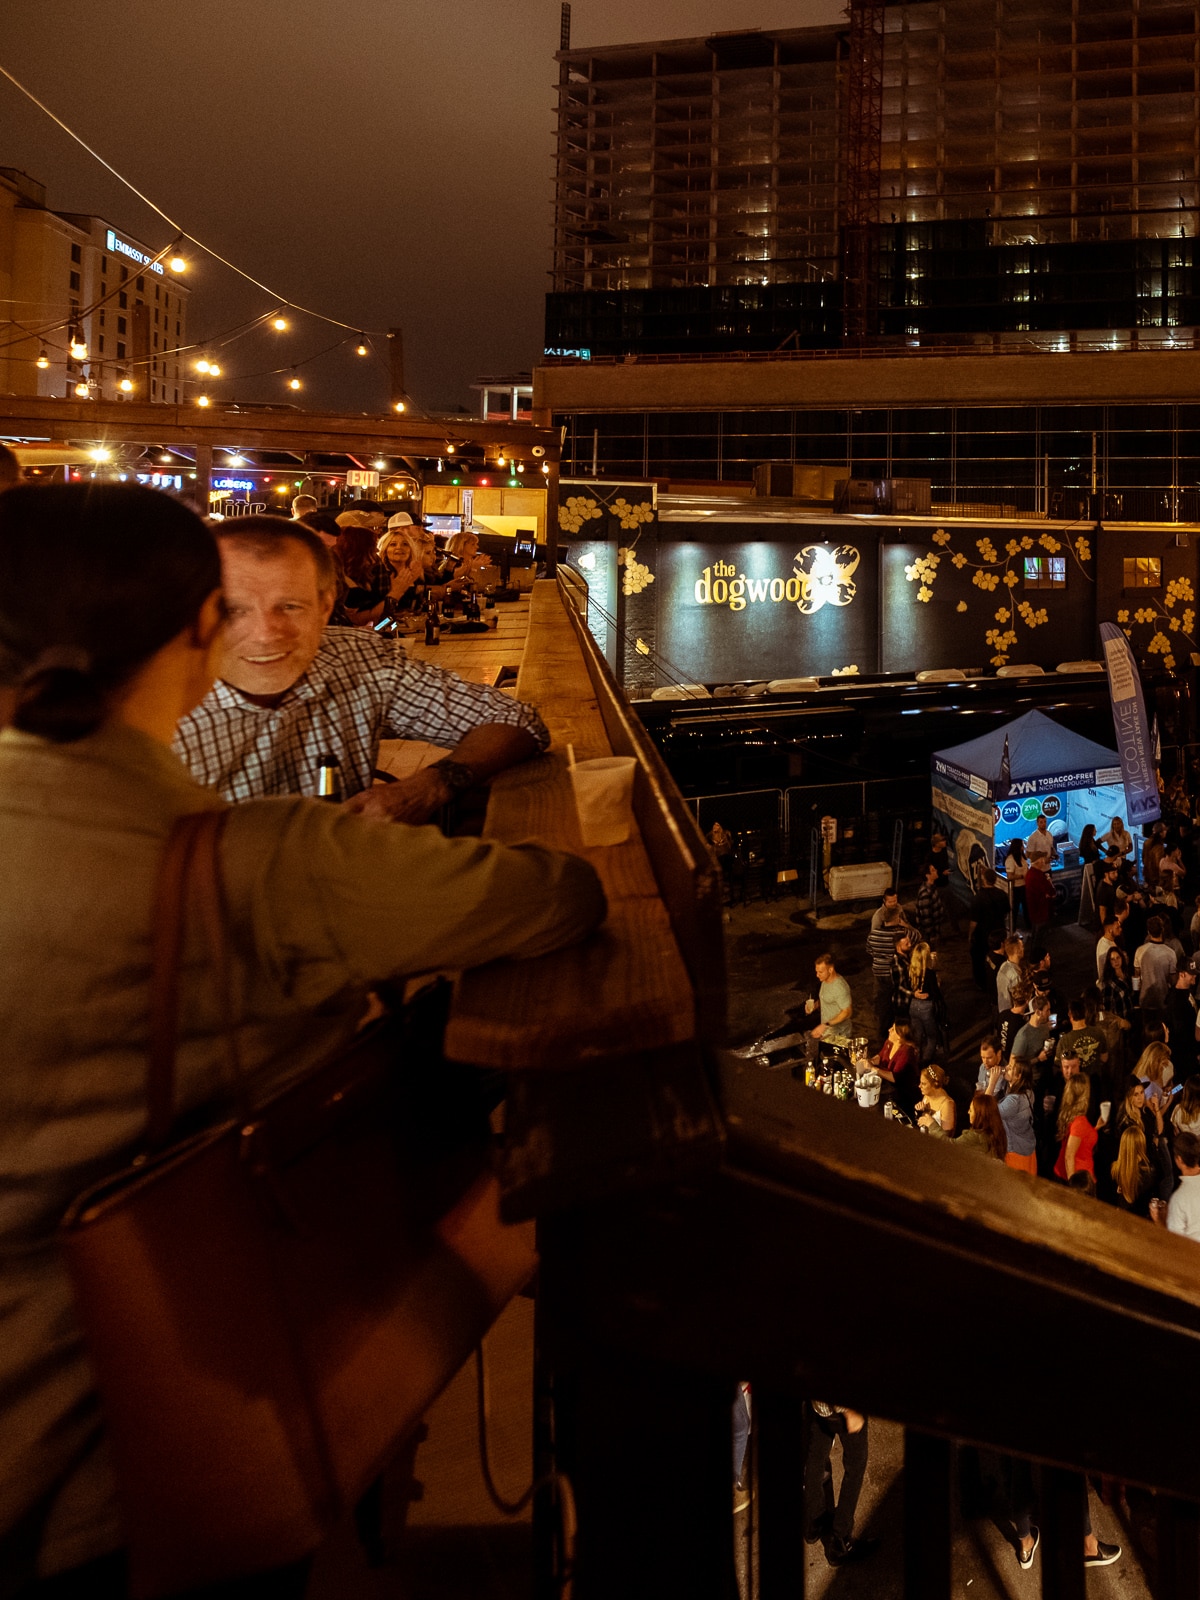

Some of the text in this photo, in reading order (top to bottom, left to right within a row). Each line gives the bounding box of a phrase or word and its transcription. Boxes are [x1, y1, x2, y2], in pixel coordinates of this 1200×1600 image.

[351, 471, 375, 486] EXIT
[712, 559, 736, 577] the
[935, 760, 947, 775] ZYN
[1038, 771, 1094, 786] TOBACCO-FREE
[1038, 778, 1095, 792] NICOTINE POUCHES
[1008, 780, 1037, 796] ZYN
[1004, 806, 1018, 814] ZYN
[1024, 803, 1038, 812] ZYN
